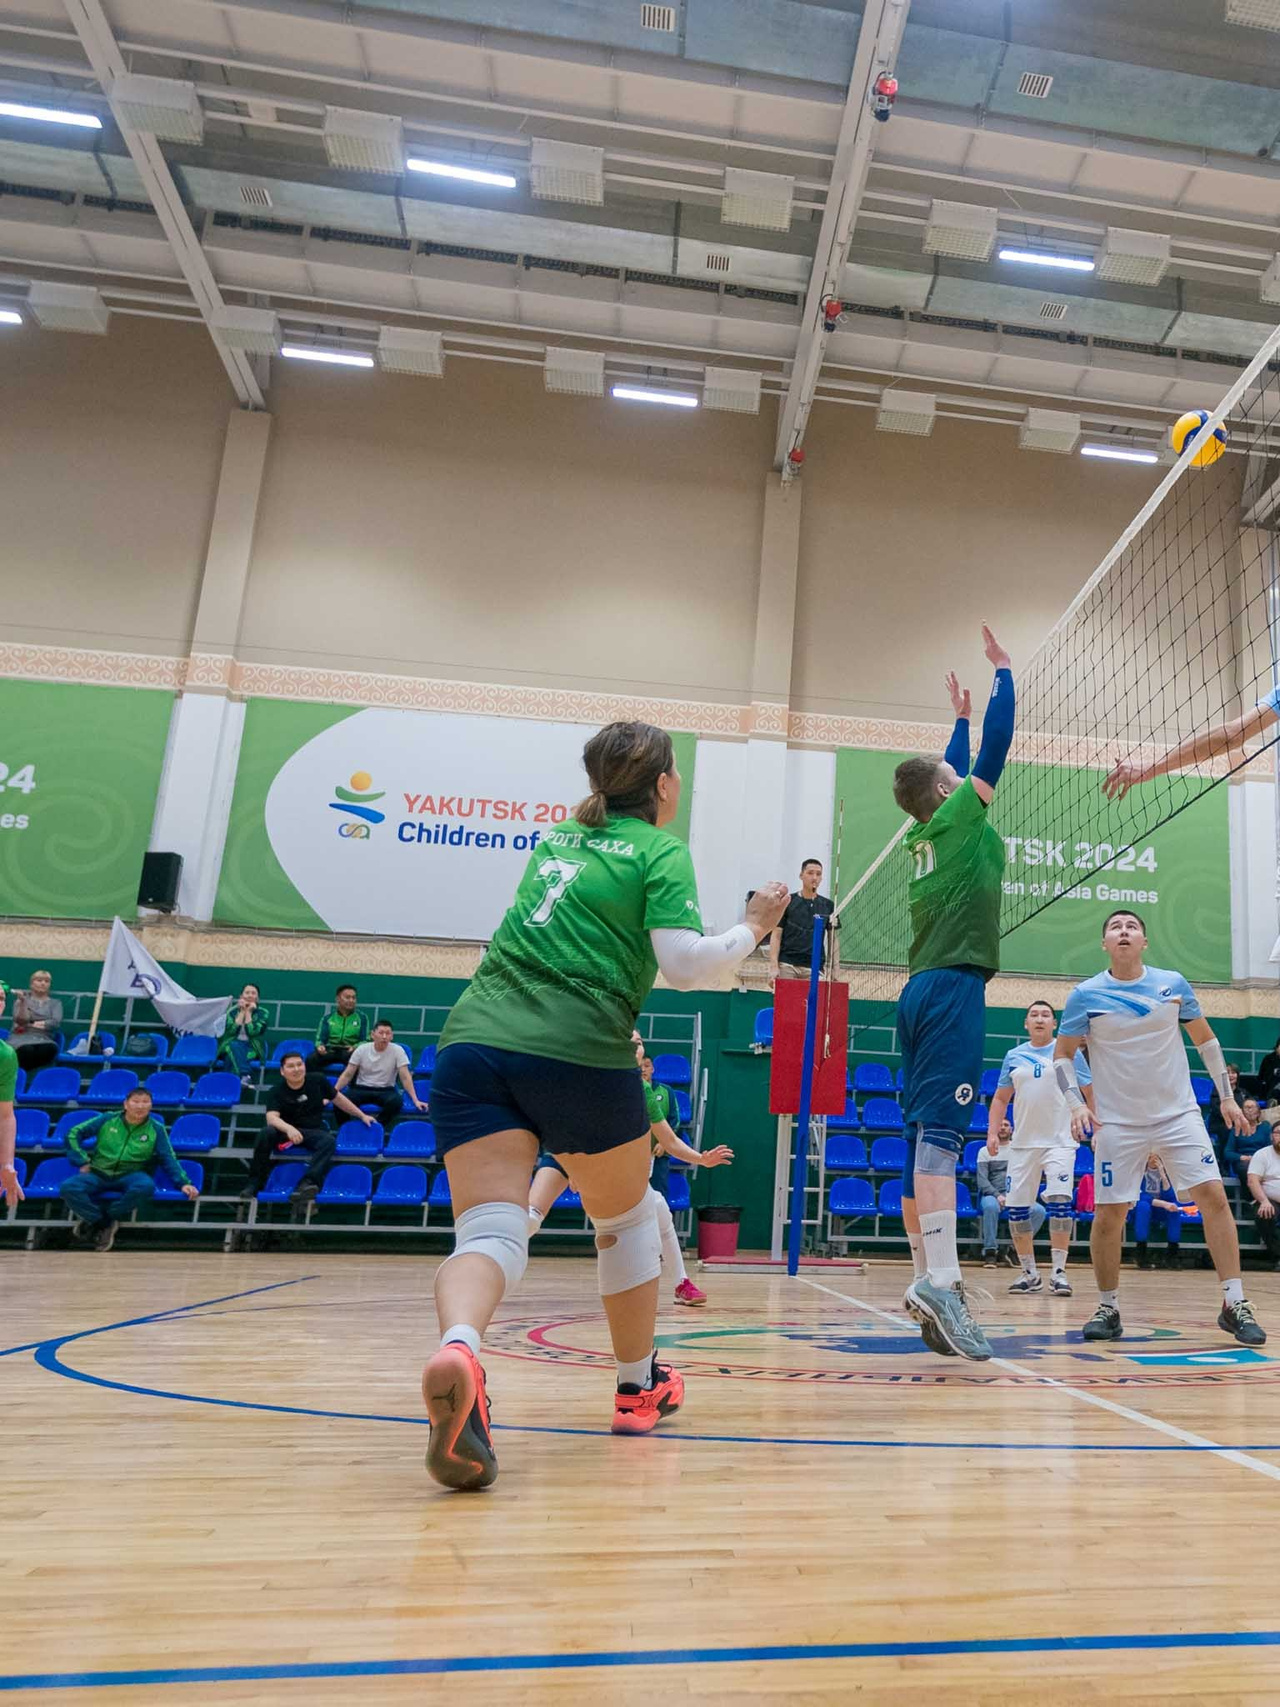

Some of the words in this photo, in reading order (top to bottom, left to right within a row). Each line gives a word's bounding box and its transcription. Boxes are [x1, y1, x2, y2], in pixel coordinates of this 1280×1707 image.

[404, 793, 527, 822] YAKUTSK
[533, 802, 574, 824] 20
[398, 822, 506, 849] Children
[513, 830, 540, 851] of
[587, 839, 635, 856] САХА
[1074, 842, 1157, 872] 2024
[523, 855, 587, 927] 7
[1054, 882, 1092, 899] Asia
[1096, 884, 1159, 903] Games
[1034, 1063, 1042, 1079] 8
[1101, 1161, 1113, 1188] 5
